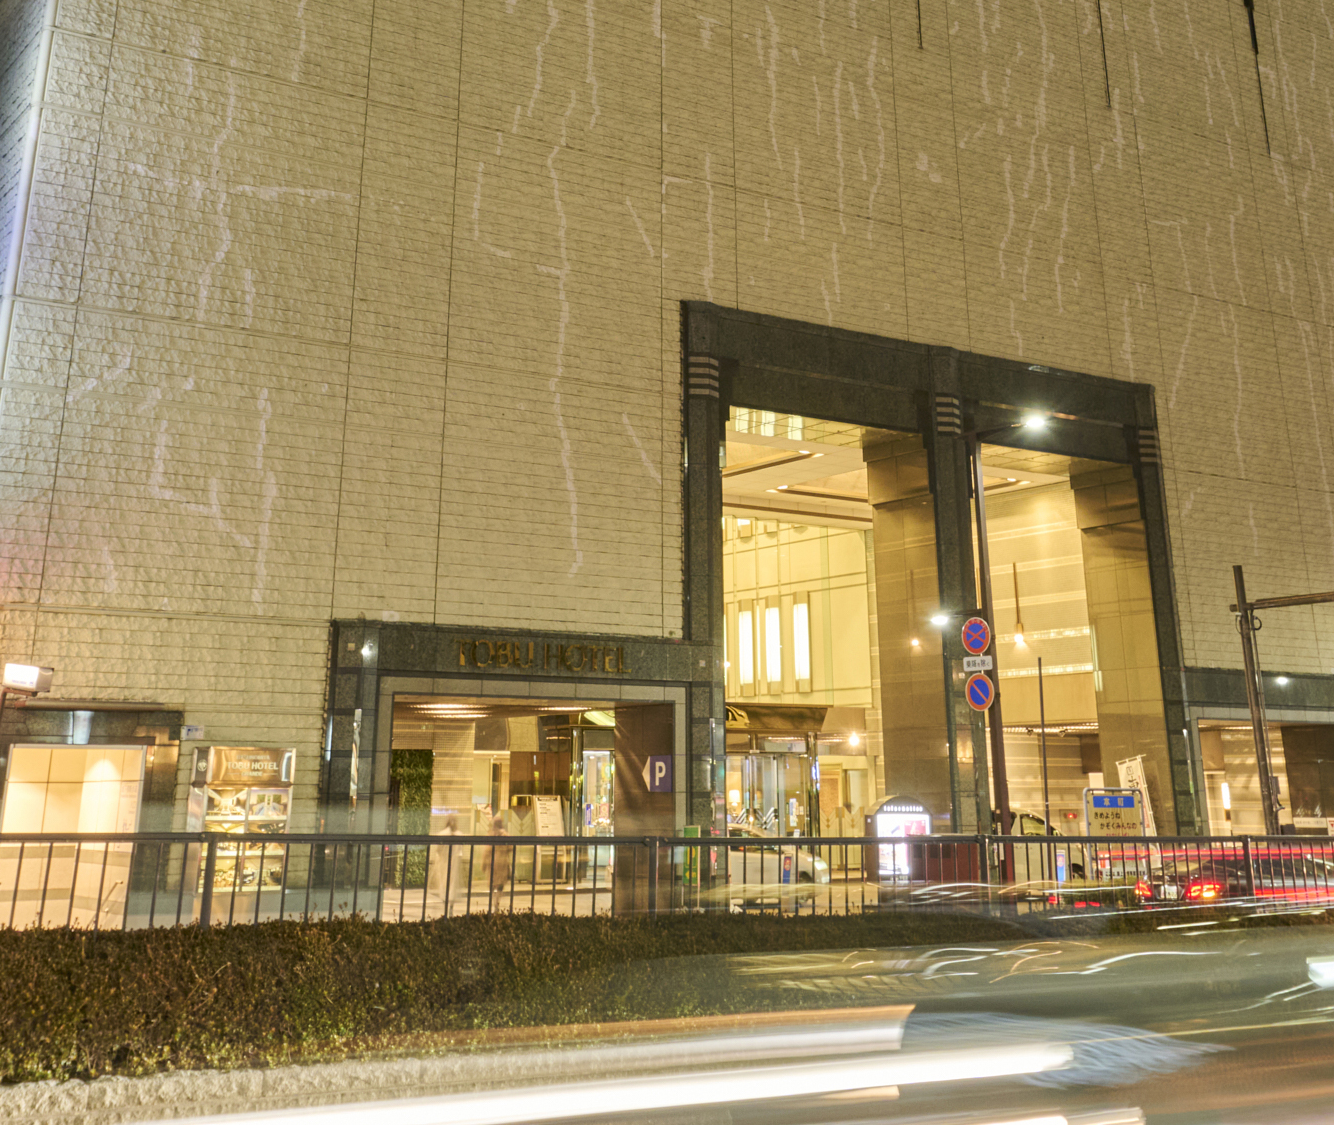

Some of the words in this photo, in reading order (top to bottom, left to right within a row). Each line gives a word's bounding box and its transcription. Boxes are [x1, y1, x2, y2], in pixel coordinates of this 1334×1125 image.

[455, 639, 535, 669] TOBU
[543, 643, 633, 674] HOTEL
[227, 761, 250, 770] TOBU
[251, 761, 279, 771] HOTEL
[654, 761, 667, 786] P
